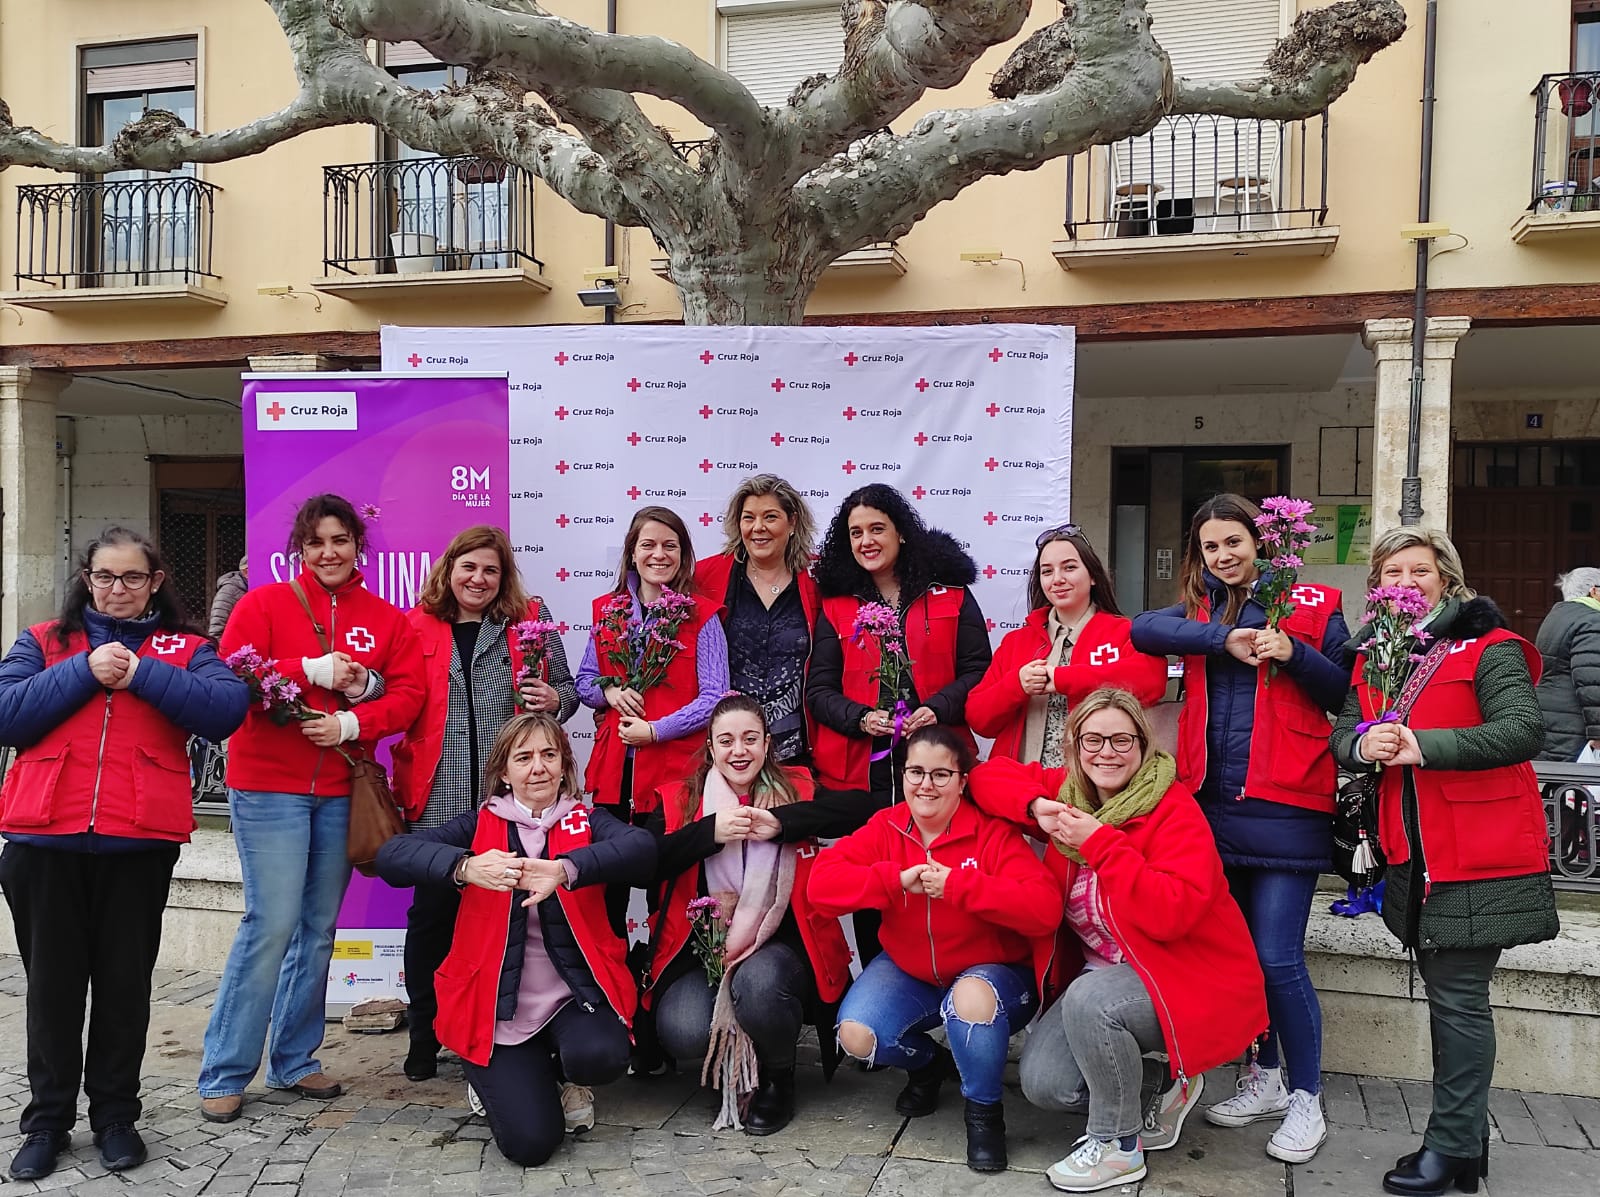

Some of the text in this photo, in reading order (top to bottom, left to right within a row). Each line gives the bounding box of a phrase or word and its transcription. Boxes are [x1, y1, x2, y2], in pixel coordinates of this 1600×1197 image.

[425, 355, 469, 366] Cruz Roja
[572, 352, 615, 363] Cruz Roja
[717, 351, 760, 363] Cruz Roja
[861, 353, 904, 364] Cruz Roja
[1006, 350, 1049, 361] Cruz Roja
[509, 381, 542, 392] uz Roja
[644, 380, 687, 391] Cruz Roja
[788, 381, 831, 391] Cruz Roja
[932, 378, 975, 389] Cruz Roja
[290, 404, 348, 418] Cruz Roja
[572, 407, 615, 417] Cruz Roja
[716, 407, 759, 417] Cruz Roja
[860, 407, 903, 418] Cruz Roja
[1003, 405, 1046, 416] Cruz Roja
[1194, 416, 1204, 430] 5
[1530, 415, 1538, 427] 4
[523, 436, 543, 446] Roja
[644, 434, 687, 445] Cruz Roja
[788, 435, 830, 446] Cruz Roja
[931, 433, 973, 443] Cruz Roja
[572, 461, 615, 471] Cruz Roja
[716, 461, 759, 471] Cruz Roja
[859, 461, 902, 472] Cruz Roja
[1002, 460, 1045, 470] Cruz Roja
[451, 465, 490, 491] 8M
[452, 491, 491, 501] DÍA DE LA
[523, 490, 543, 500] Roja
[644, 488, 687, 498] Cruz Roja
[810, 489, 830, 499] Roja
[929, 487, 972, 497] Cruz Roja
[573, 514, 615, 525] Cruz Roja
[1001, 514, 1044, 524] Cruz Roja
[524, 544, 544, 554] Roja
[573, 568, 613, 579] Cruz Roja
[1000, 568, 1021, 576] Cruz
[572, 624, 593, 632] Cruz
[999, 621, 1020, 629] Cruz
[571, 730, 593, 740] Cruz
